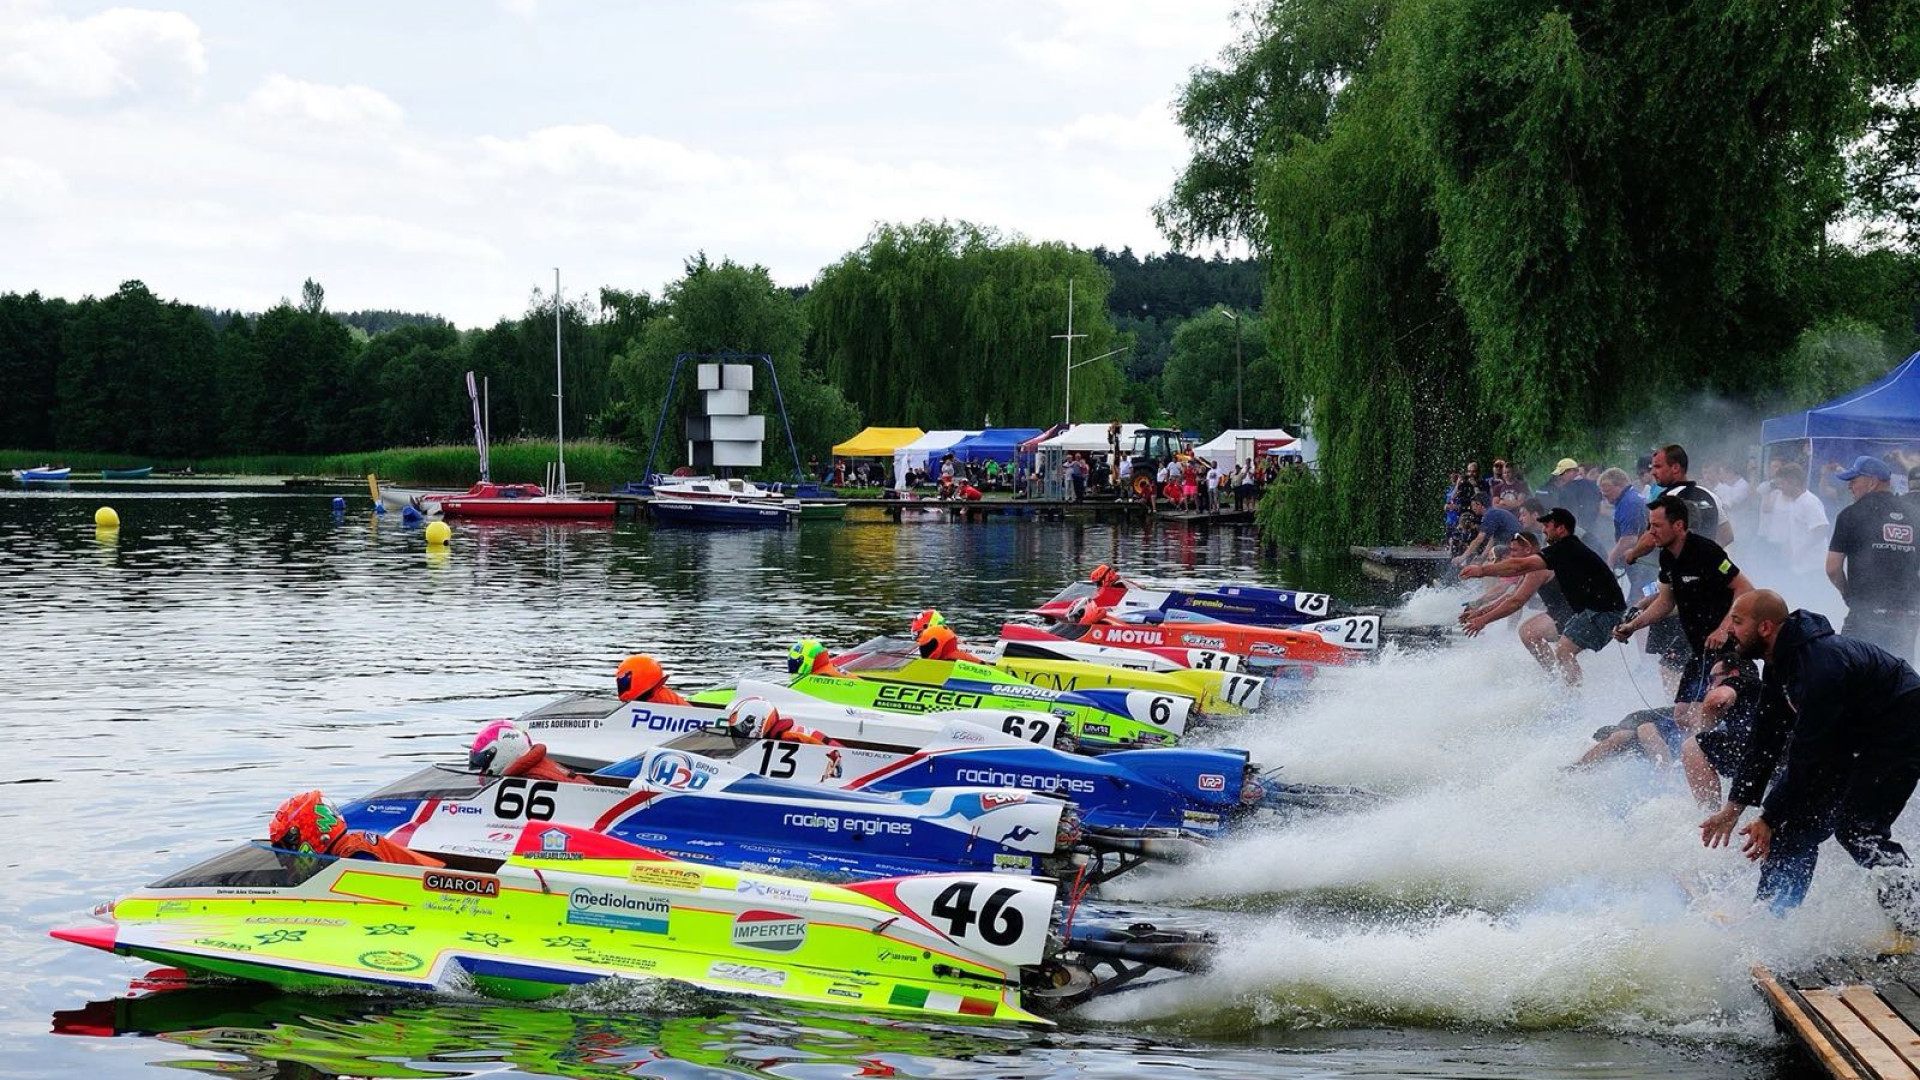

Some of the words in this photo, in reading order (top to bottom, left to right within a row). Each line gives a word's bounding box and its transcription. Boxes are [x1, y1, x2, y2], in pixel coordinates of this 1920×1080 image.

[1886, 527, 1910, 540] VRP
[1299, 594, 1328, 611] 15
[1105, 629, 1164, 646] MOTUL
[1344, 619, 1374, 643] 22
[1196, 651, 1230, 671] 31
[878, 685, 984, 709] EFFECI
[1226, 676, 1261, 706] 17
[876, 701, 902, 709] RACING
[1150, 696, 1175, 725] 6
[1002, 716, 1050, 744] 62
[695, 761, 720, 775] BRNO
[759, 741, 799, 779] 13
[956, 767, 1016, 787] racing
[1020, 774, 1095, 793] engines
[1200, 777, 1223, 788] VRP
[494, 778, 559, 822] 66
[784, 812, 840, 832] racing
[843, 818, 913, 836] engines
[427, 875, 495, 894] GIAROLA
[575, 892, 670, 914] mediolanum
[931, 881, 1024, 946] 46
[734, 924, 807, 938] IMPERTEK
